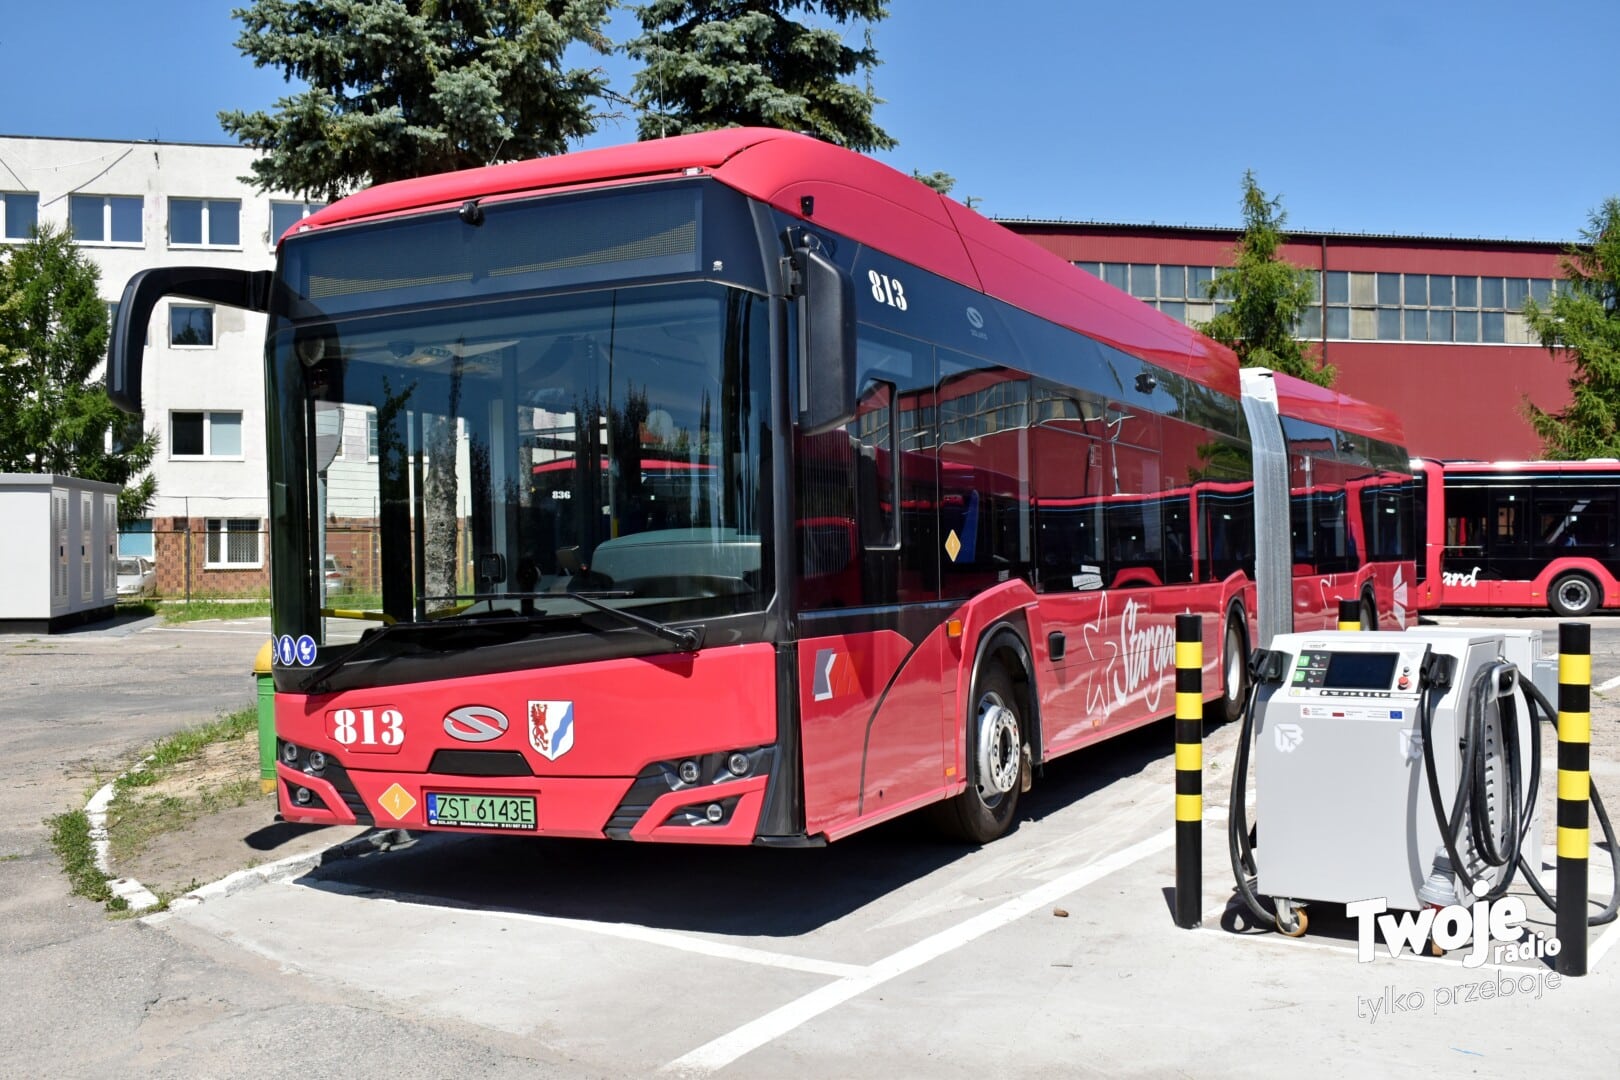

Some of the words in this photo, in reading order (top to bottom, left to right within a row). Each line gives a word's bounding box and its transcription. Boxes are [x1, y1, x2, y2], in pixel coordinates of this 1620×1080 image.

[868, 269, 908, 311] 813
[552, 490, 571, 499] 836
[333, 709, 405, 746] 813
[437, 797, 470, 819] ZST
[476, 799, 532, 822] 6143E
